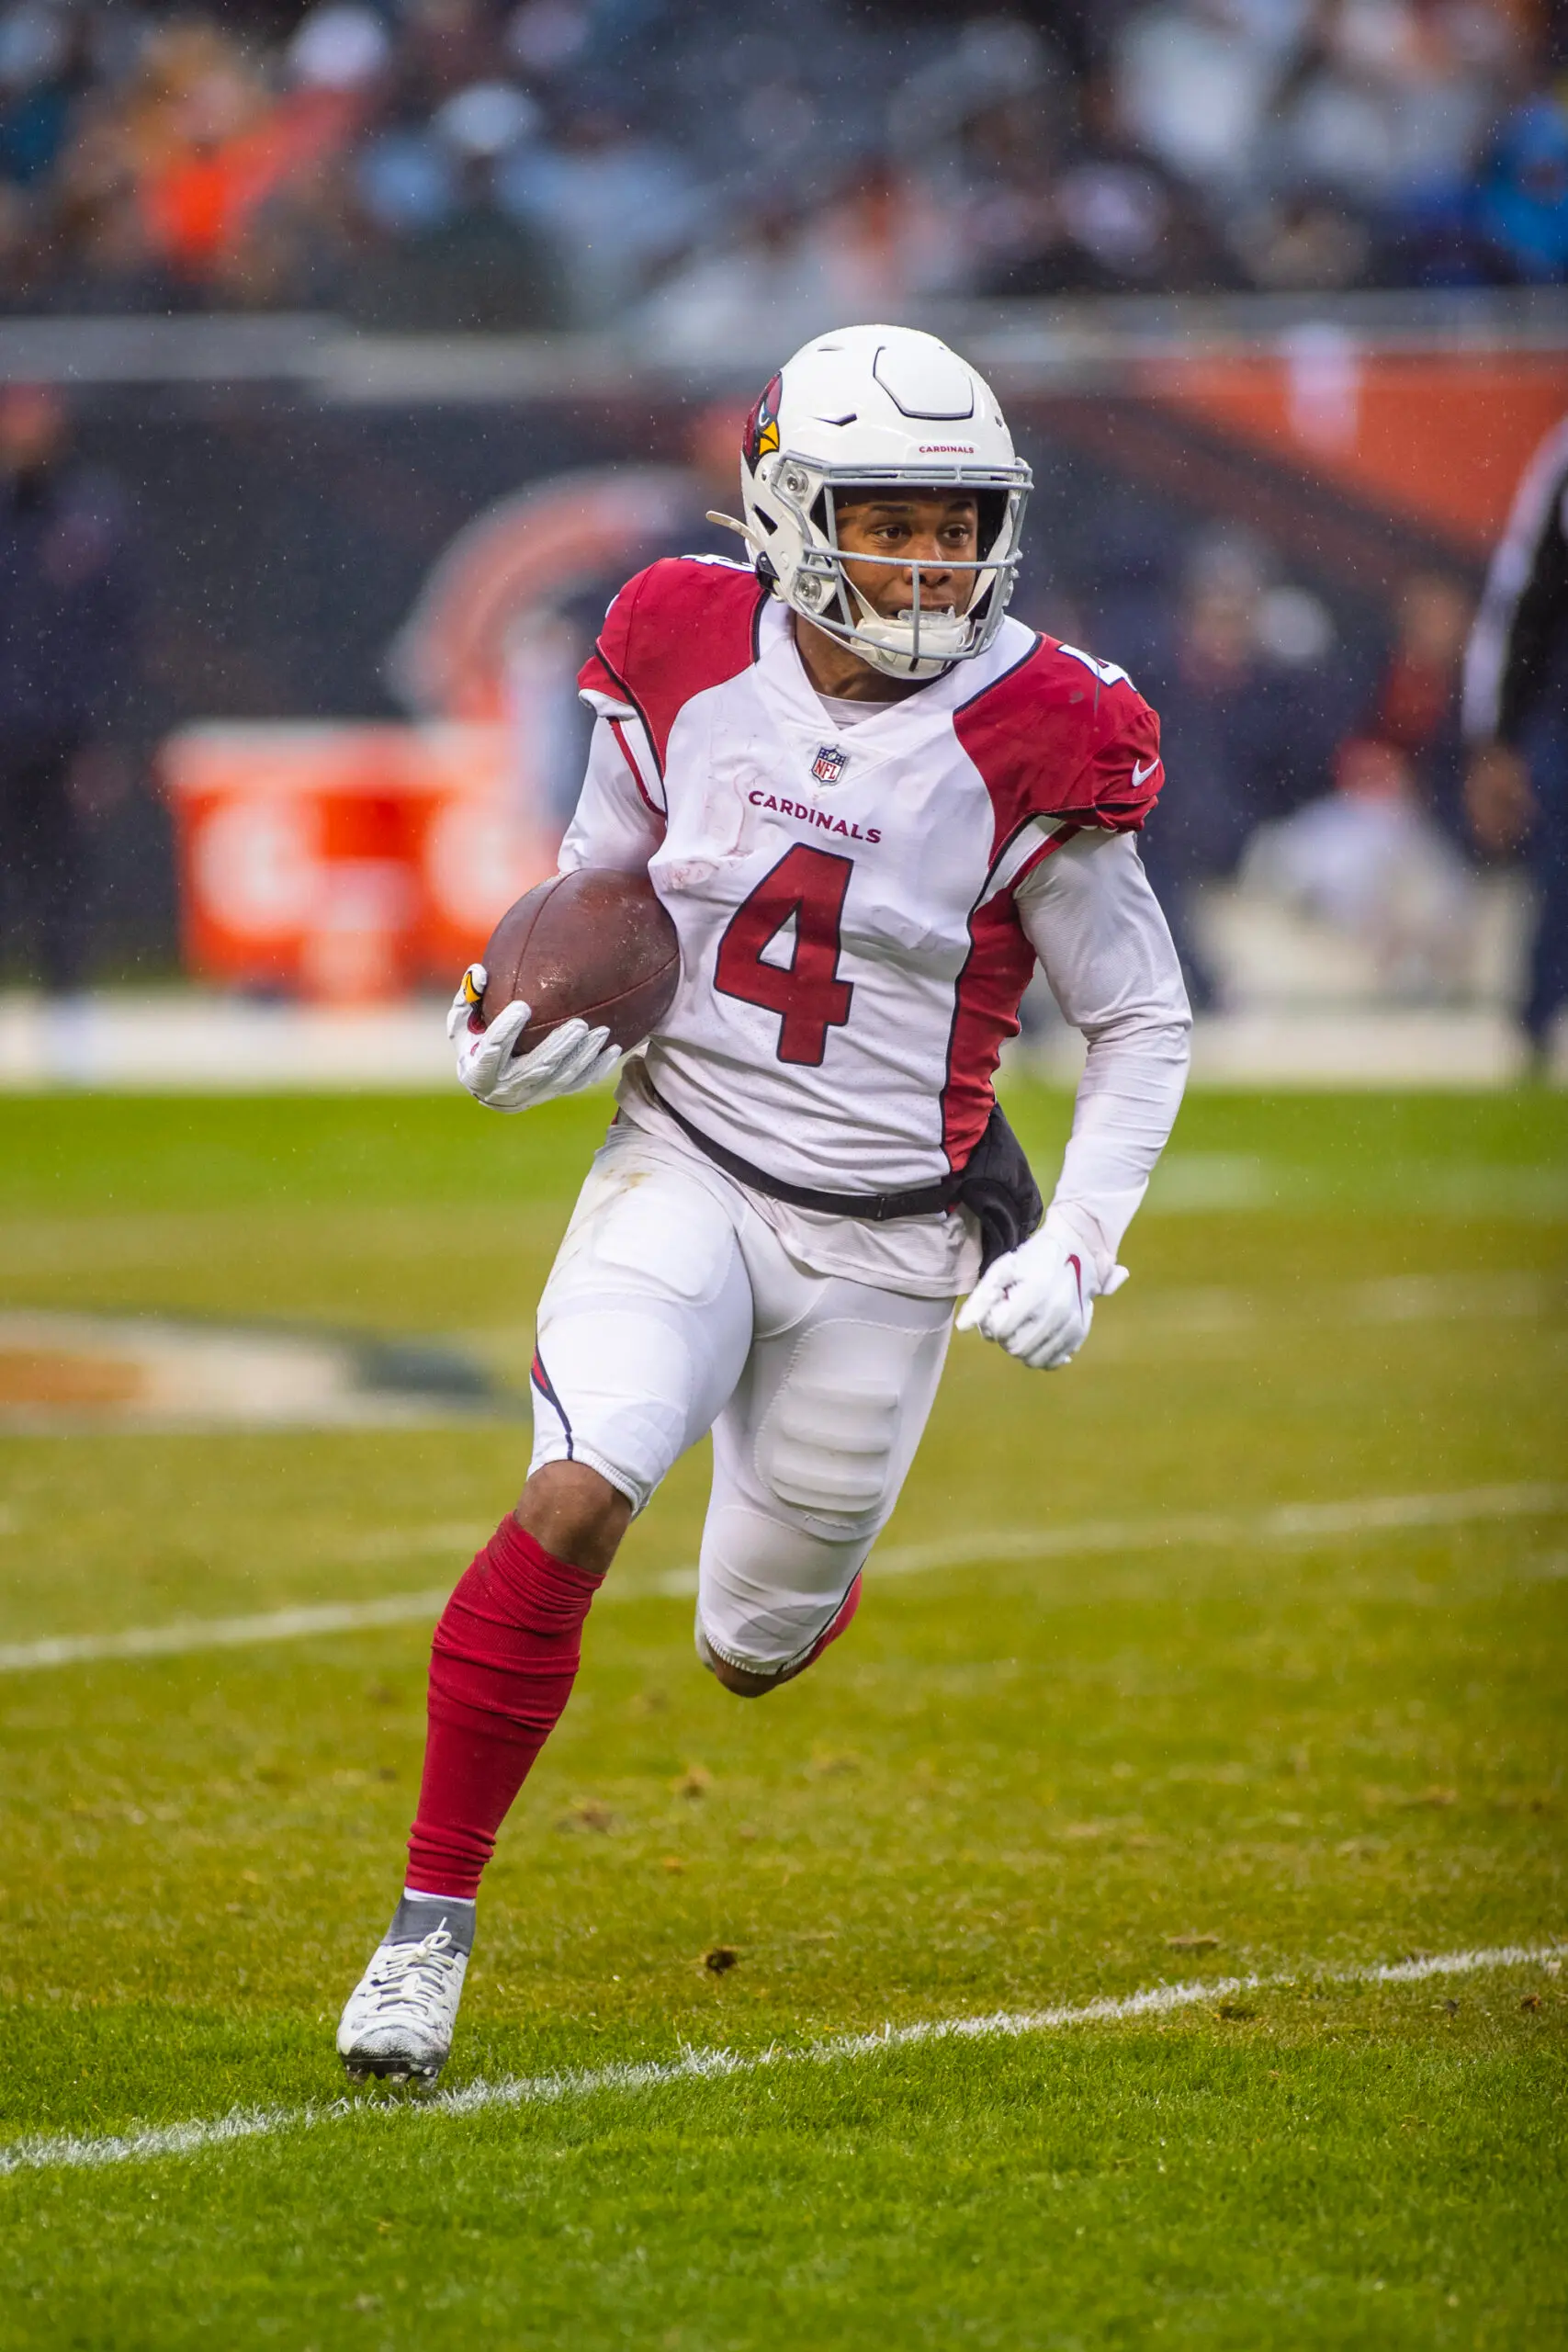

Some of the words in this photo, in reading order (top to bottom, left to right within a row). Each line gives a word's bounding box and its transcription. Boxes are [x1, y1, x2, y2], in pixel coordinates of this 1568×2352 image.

[919, 446, 975, 454] CARDINALS
[814, 759, 837, 780] NFL
[748, 790, 882, 844] CARDINALS
[714, 842, 854, 1068] 4
